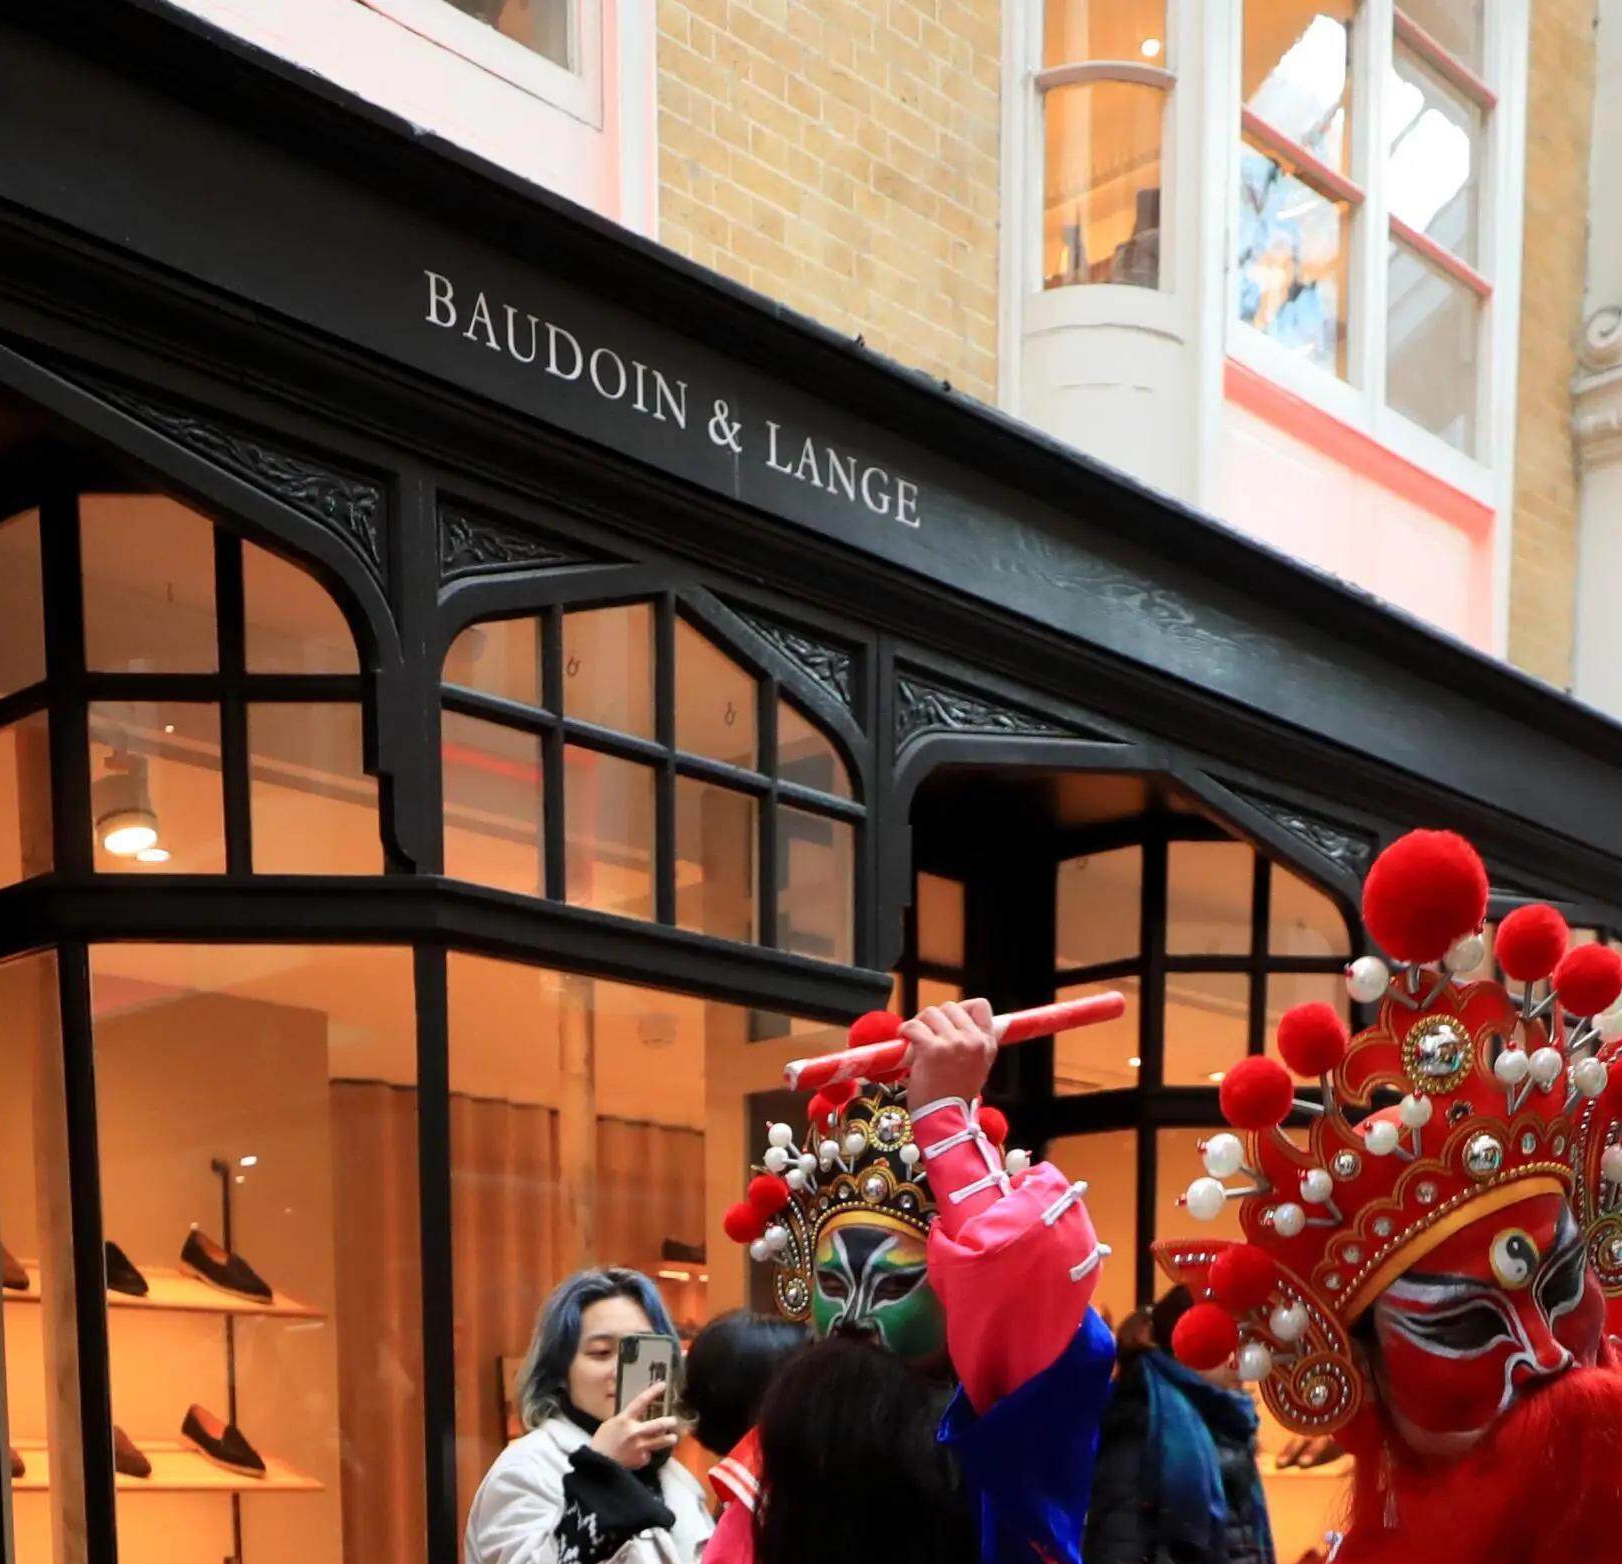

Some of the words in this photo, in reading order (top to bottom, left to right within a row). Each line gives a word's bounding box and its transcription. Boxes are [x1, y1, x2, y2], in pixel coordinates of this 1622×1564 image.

[423, 269, 689, 430] BAUDOIN
[707, 398, 744, 454] &
[764, 420, 922, 529] LANGE
